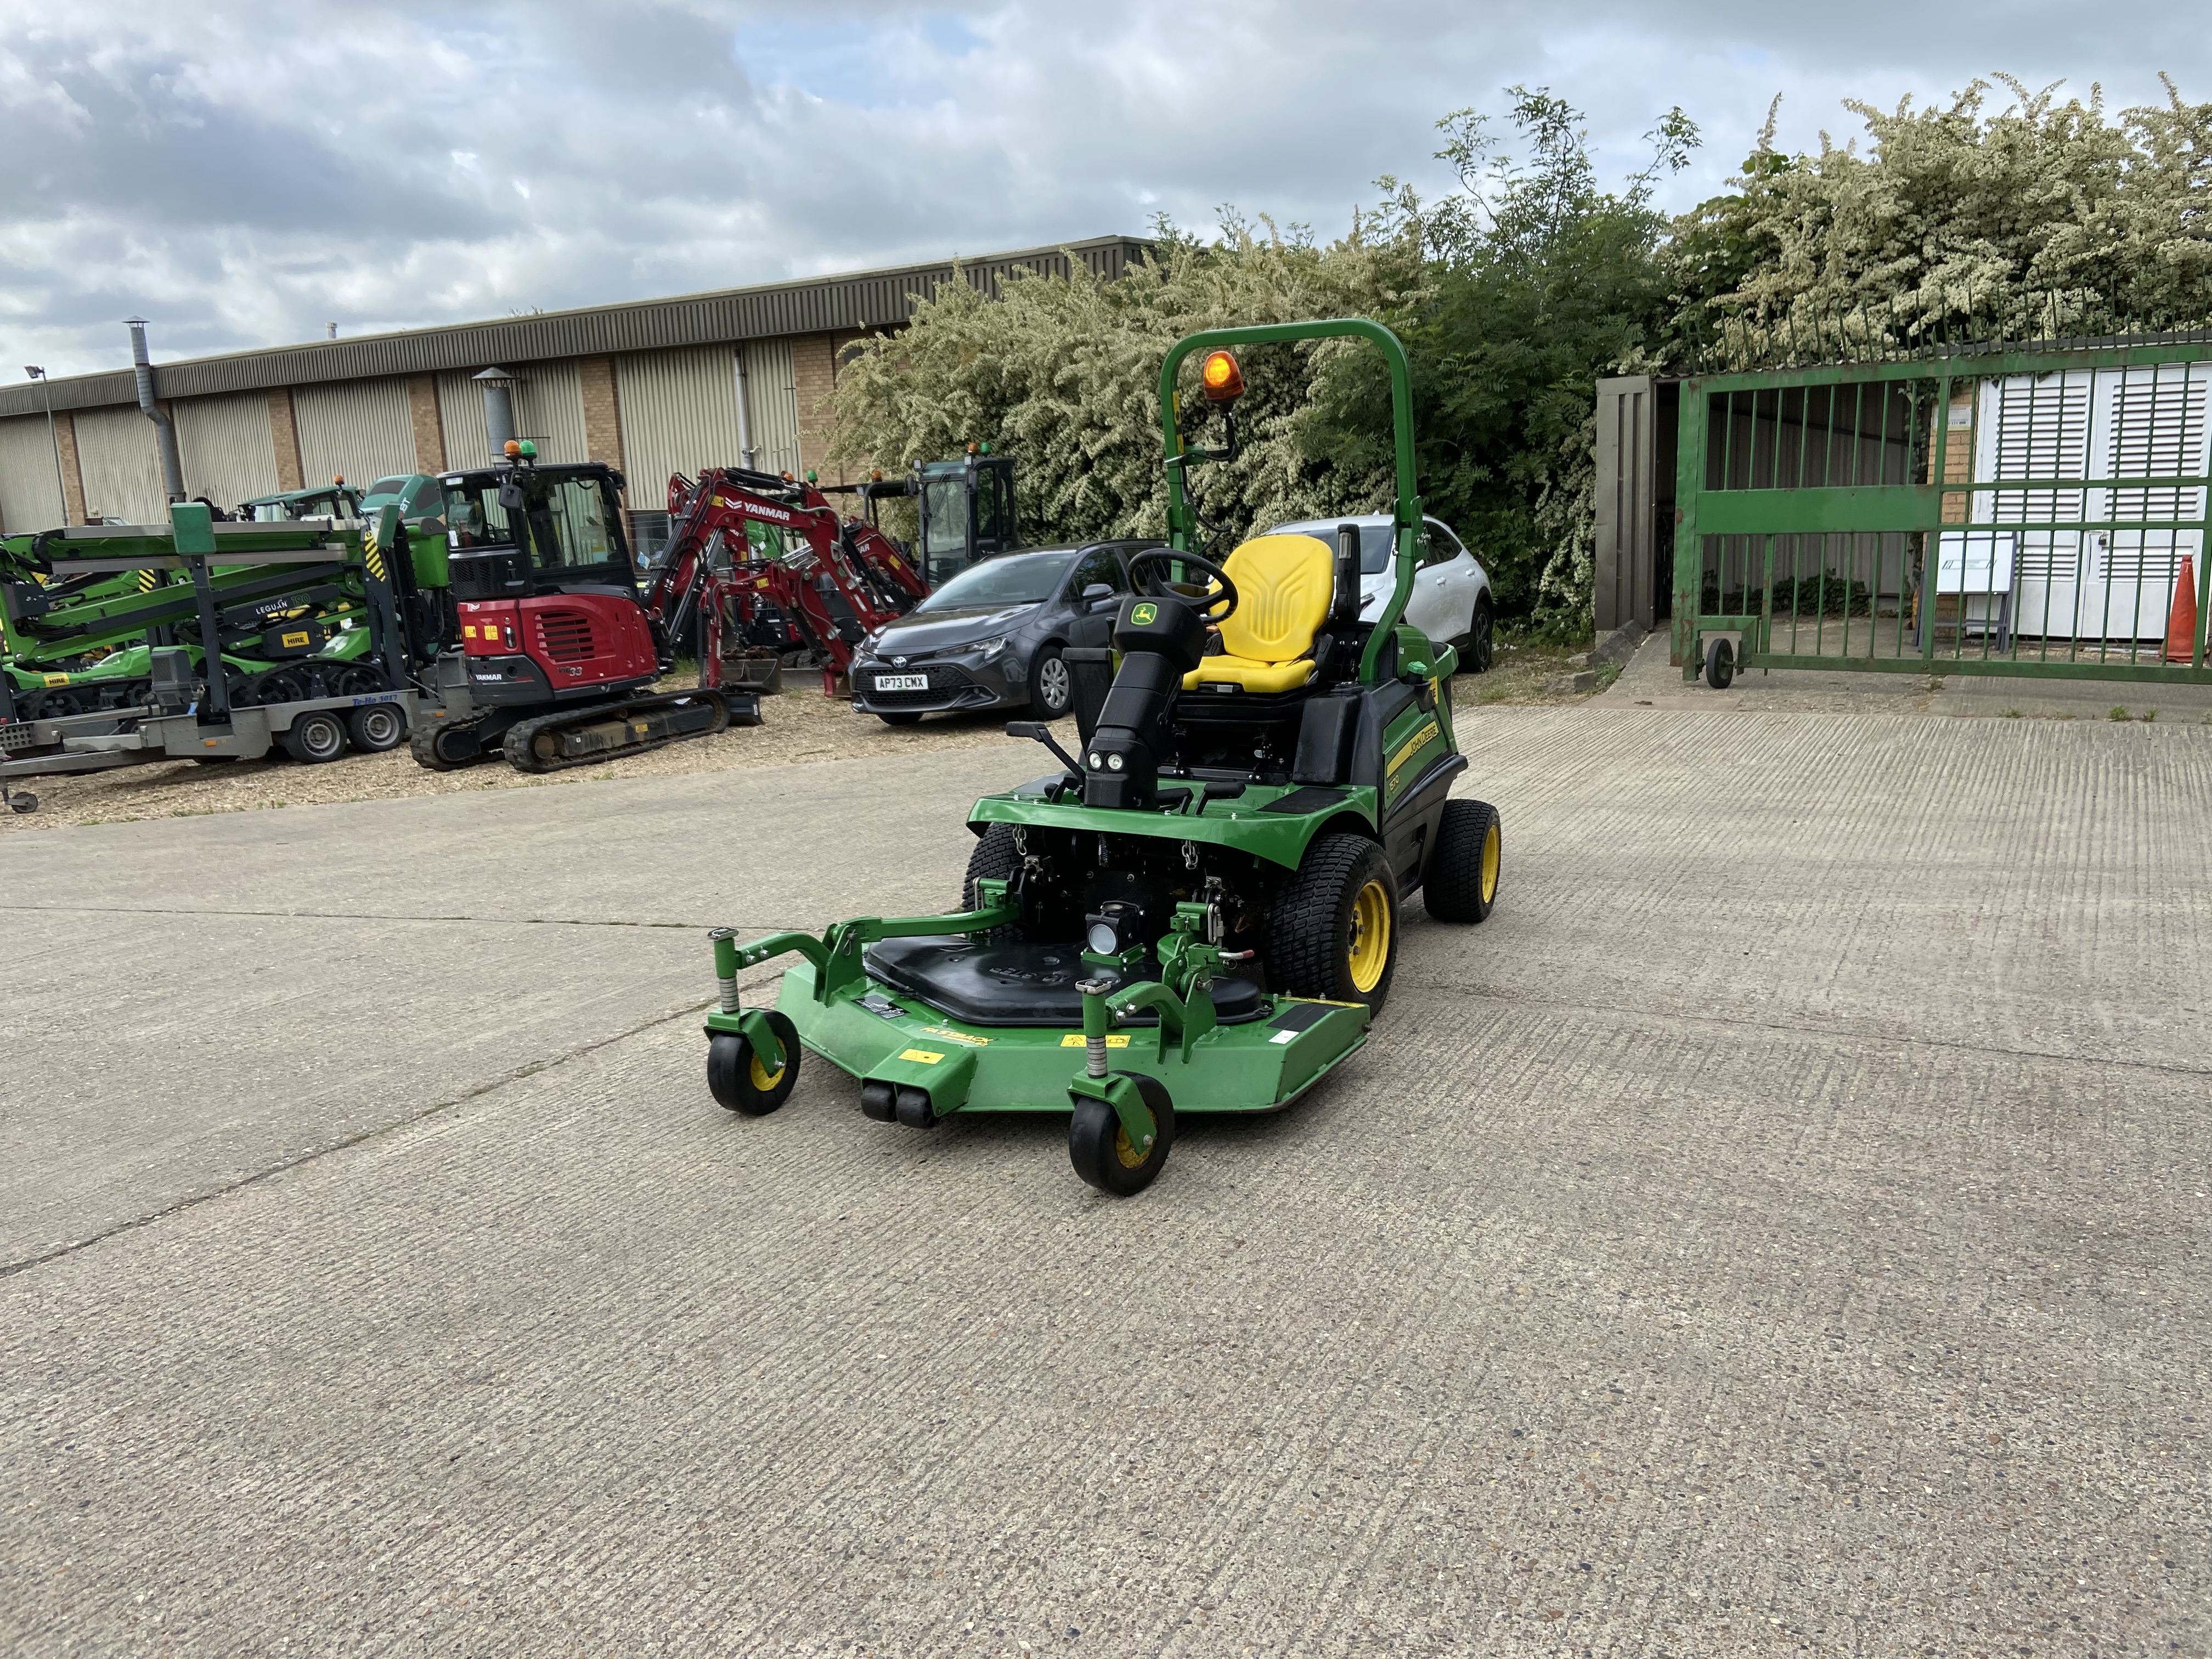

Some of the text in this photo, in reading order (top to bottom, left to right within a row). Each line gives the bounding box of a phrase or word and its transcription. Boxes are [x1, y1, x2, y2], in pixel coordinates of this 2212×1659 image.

[744, 502, 790, 521] YANMAR
[256, 597, 287, 614] LEGUAN
[287, 636, 305, 645] HIRE
[879, 676, 923, 689] AP73 CMX
[380, 694, 397, 702] 3017
[1410, 725, 1437, 755] JOHN DEERE
